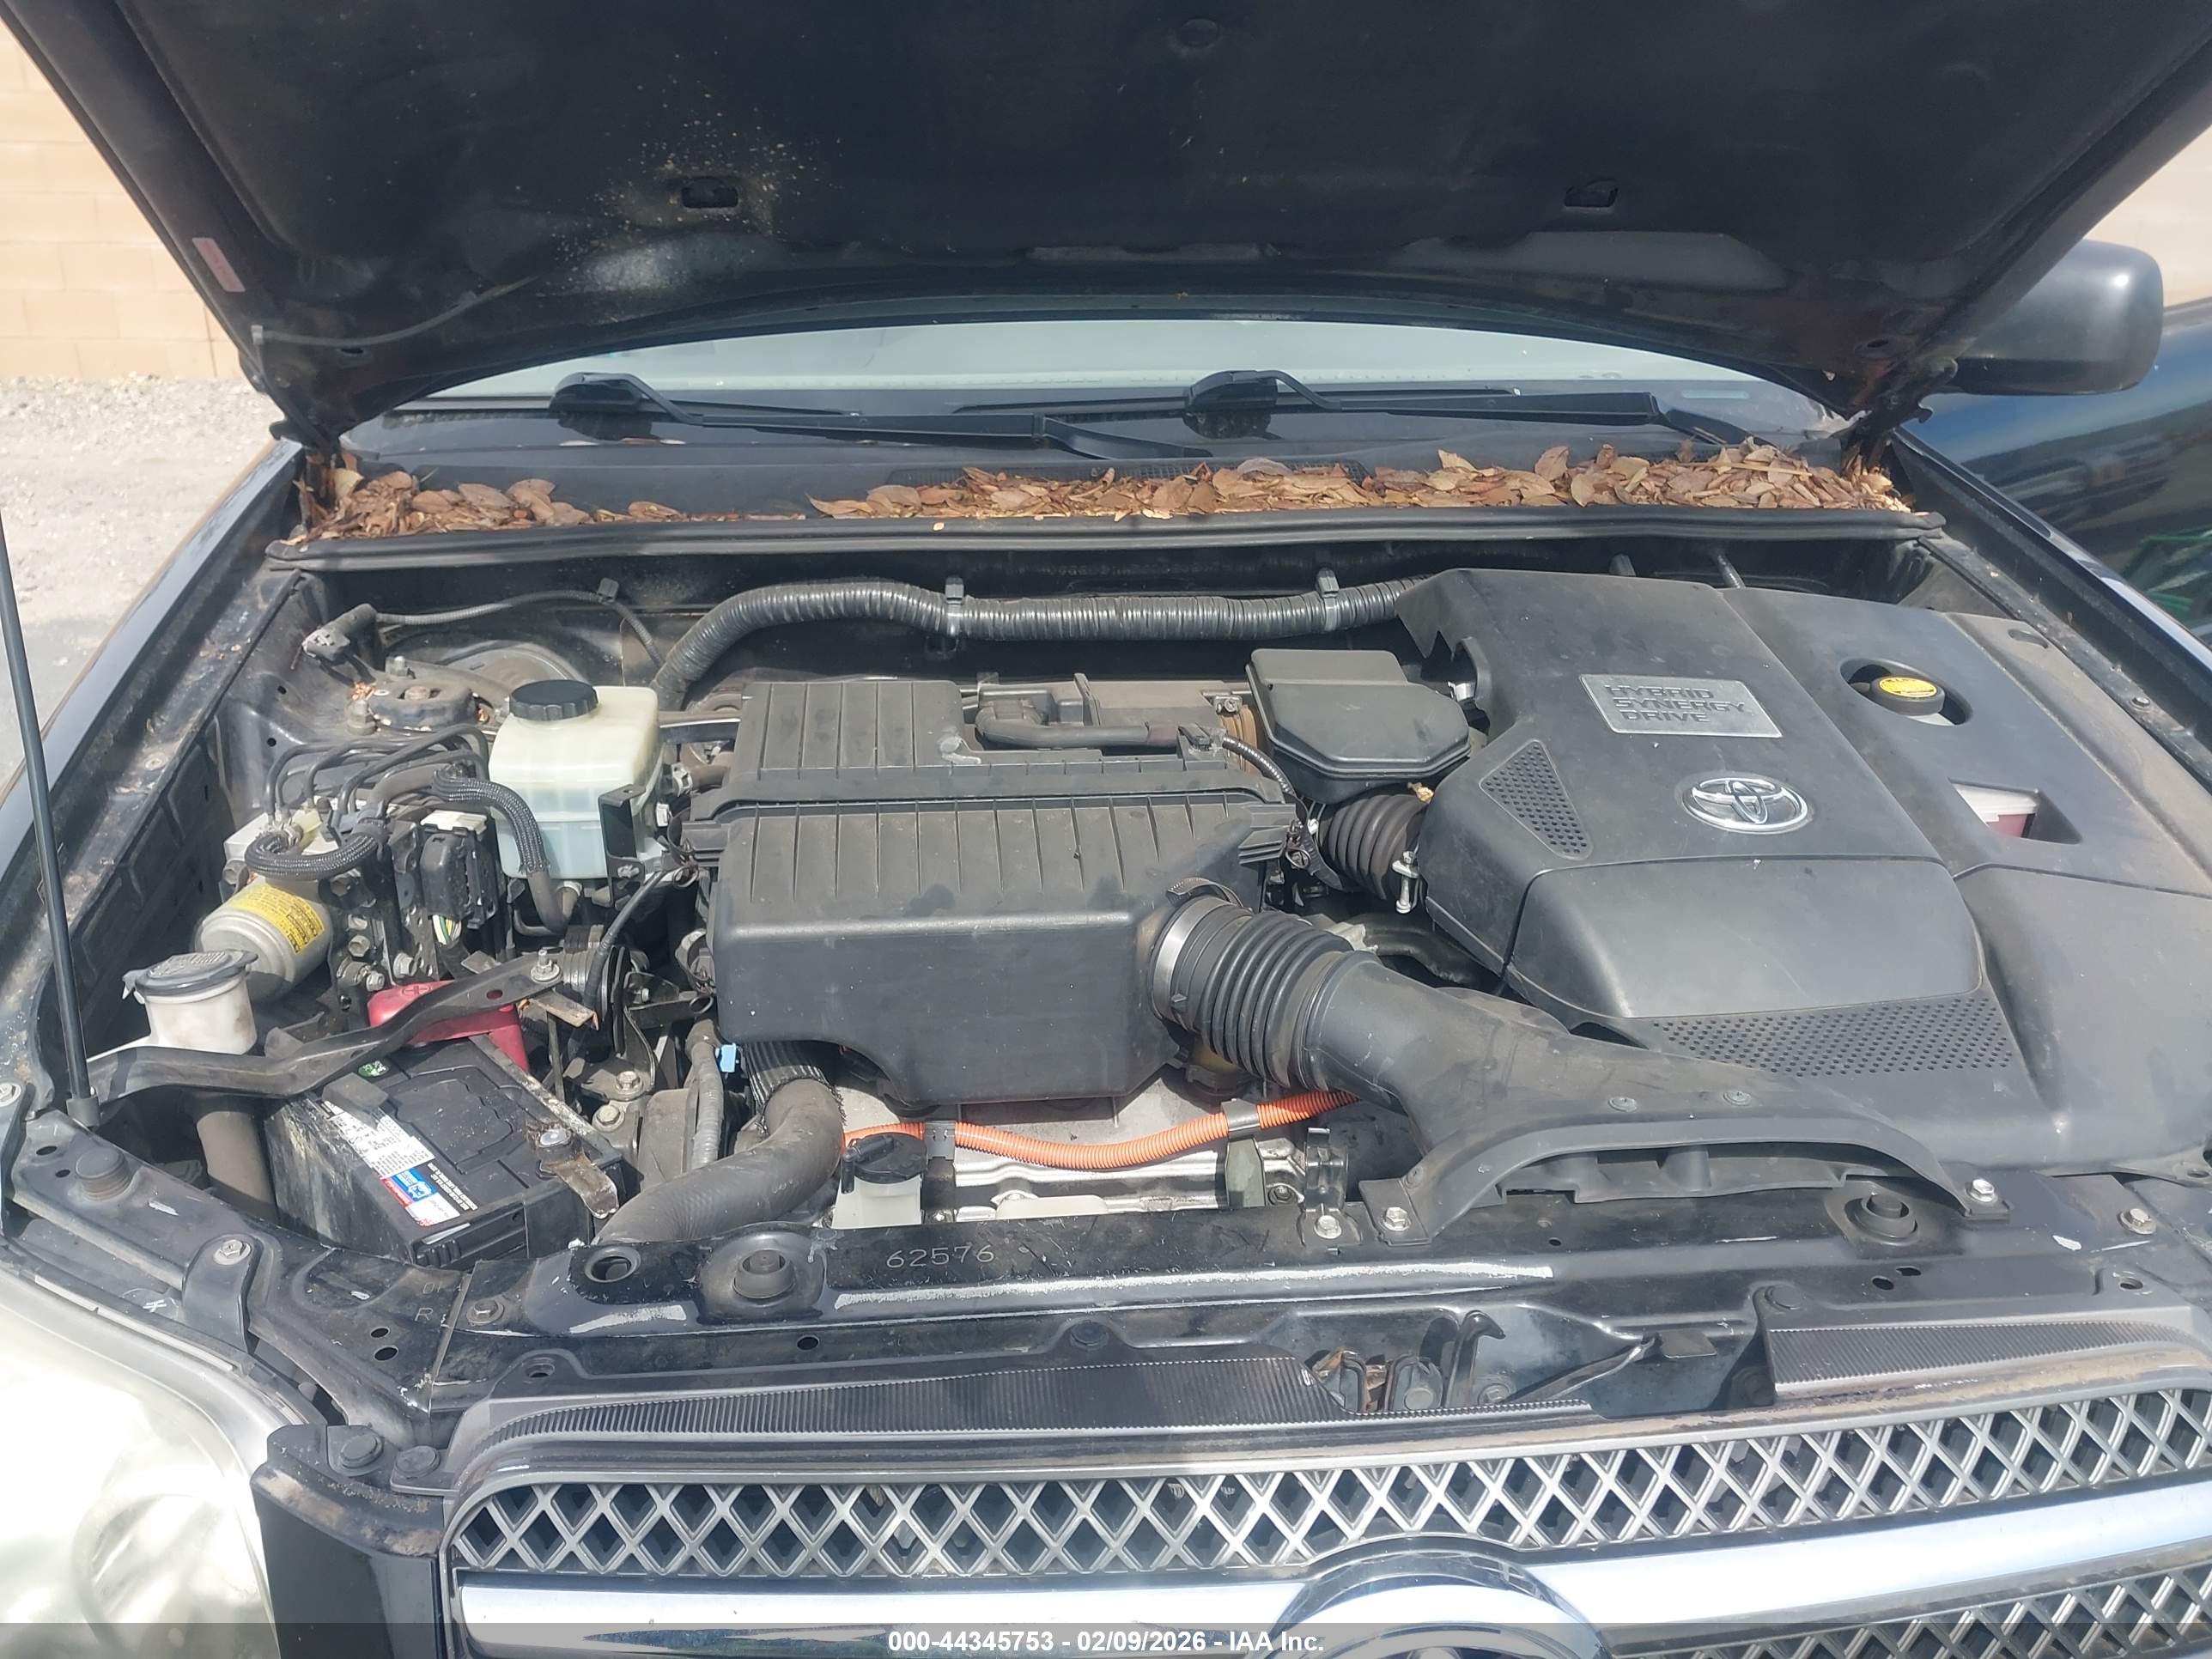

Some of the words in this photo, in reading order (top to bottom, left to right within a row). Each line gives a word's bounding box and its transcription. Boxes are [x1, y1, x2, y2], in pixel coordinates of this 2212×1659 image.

[1604, 684, 1715, 699] HYBRID
[1612, 696, 1747, 714] SYNERGY
[1619, 709, 1711, 723] DRIVE
[886, 1244, 994, 1268] 62576
